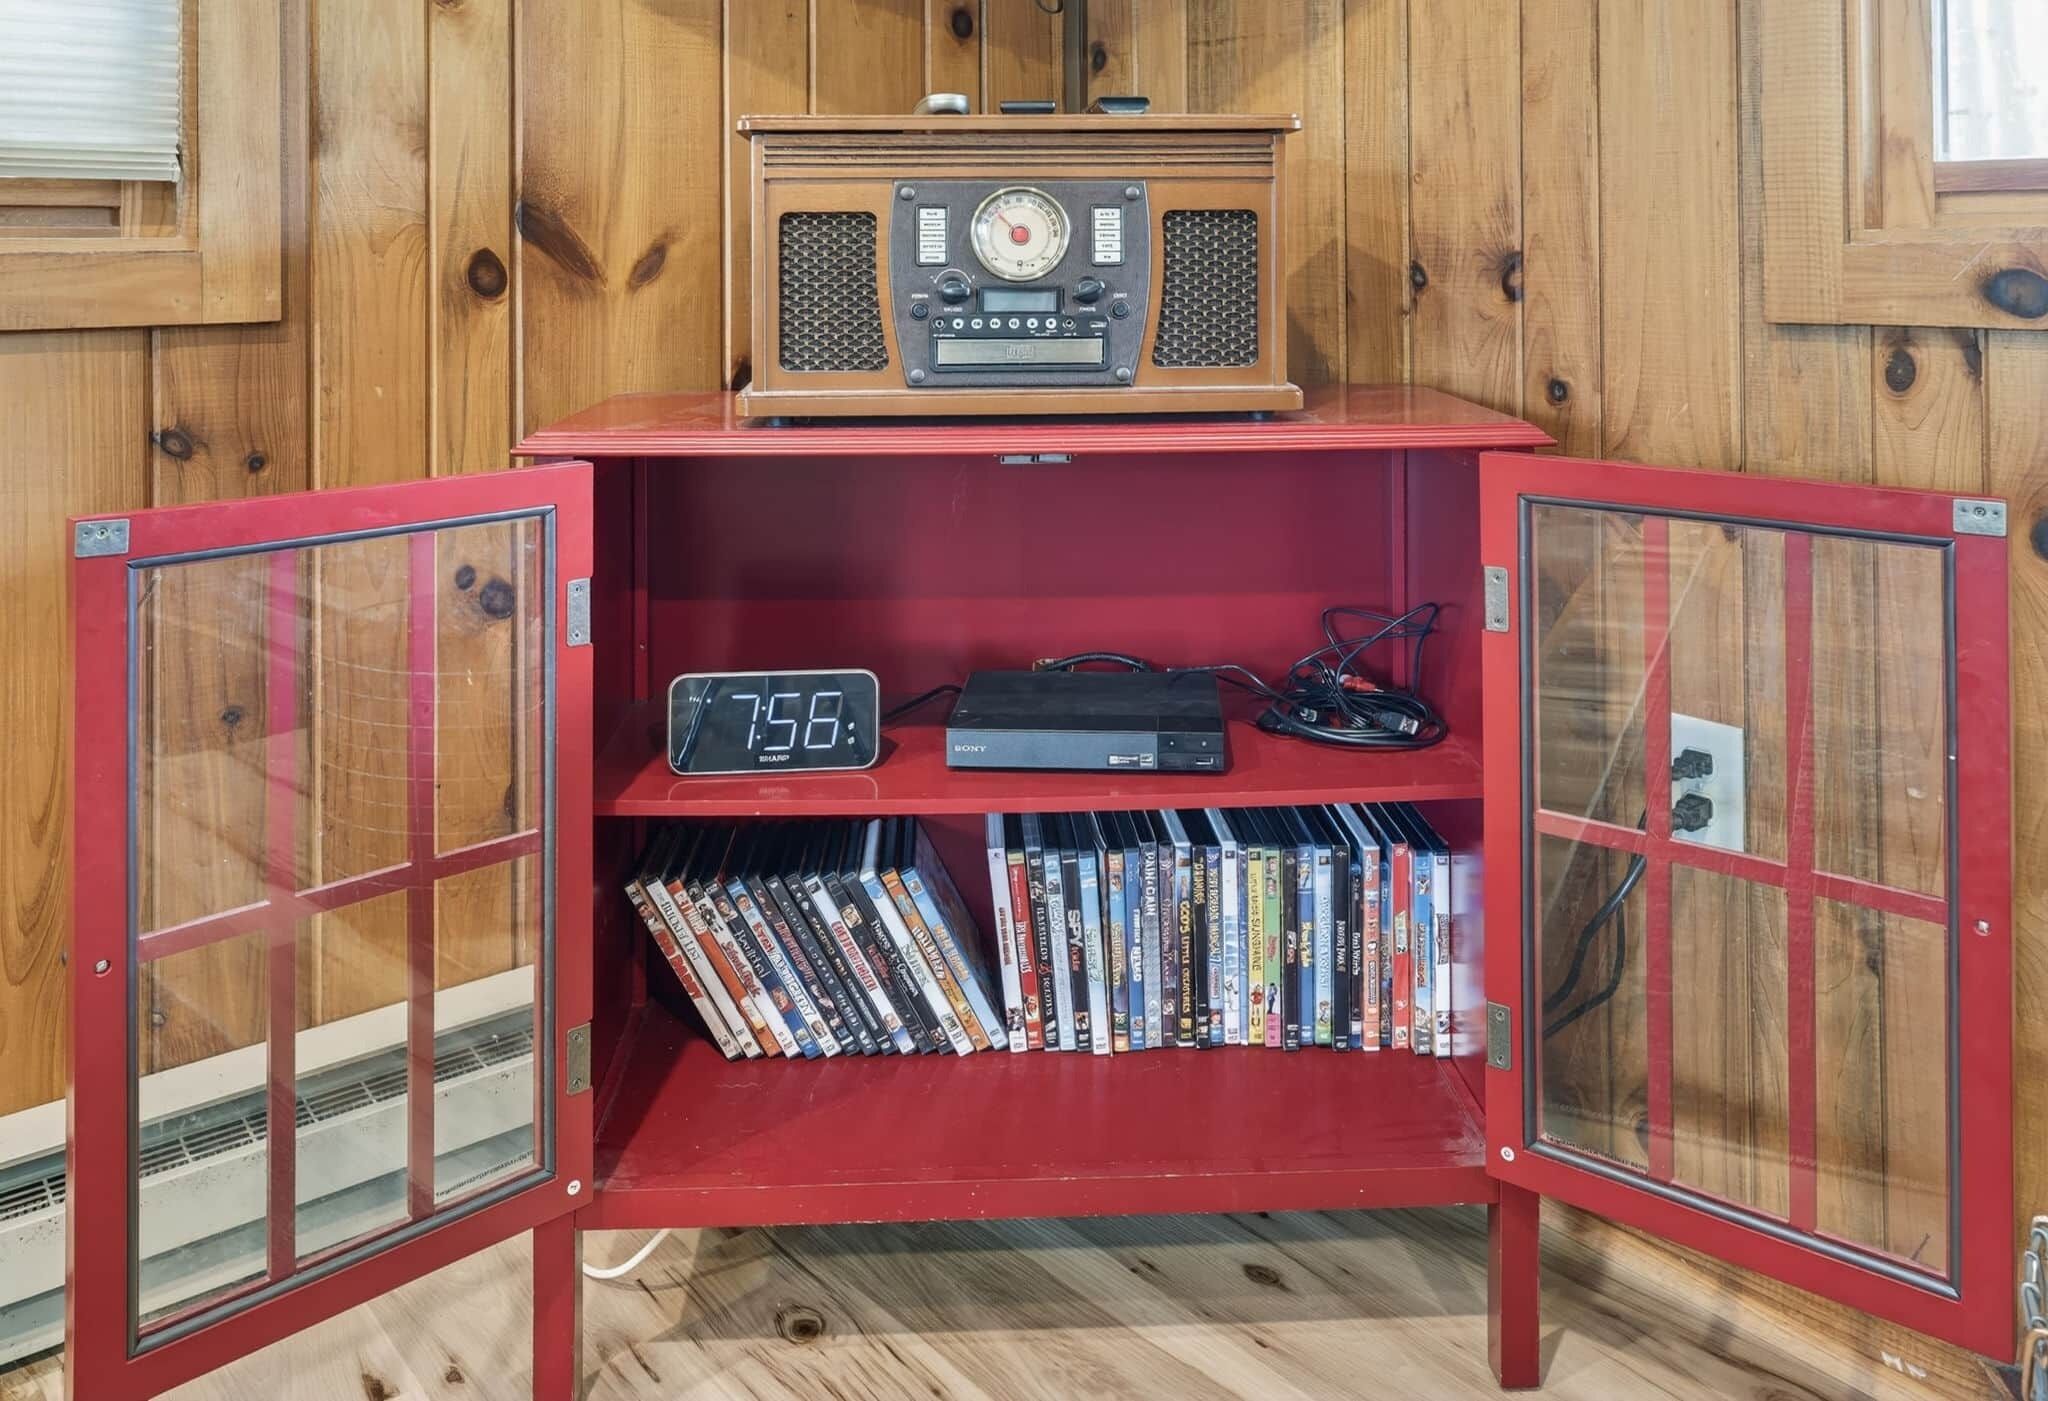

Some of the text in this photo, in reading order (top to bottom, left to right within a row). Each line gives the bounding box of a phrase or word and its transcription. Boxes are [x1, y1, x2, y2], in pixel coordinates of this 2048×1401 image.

[731, 691, 843, 751] 7:58
[758, 754, 790, 763] SHARP
[953, 743, 988, 753] SONY
[1066, 909, 1083, 950] SPY
[1178, 900, 1190, 934] GOD'S
[685, 940, 703, 962] LIST
[1180, 934, 1190, 964] LITTLE
[1251, 917, 1262, 971] SUNSHINE
[1129, 944, 1143, 982] NEMO
[770, 951, 818, 1018] ALMIGHTY
